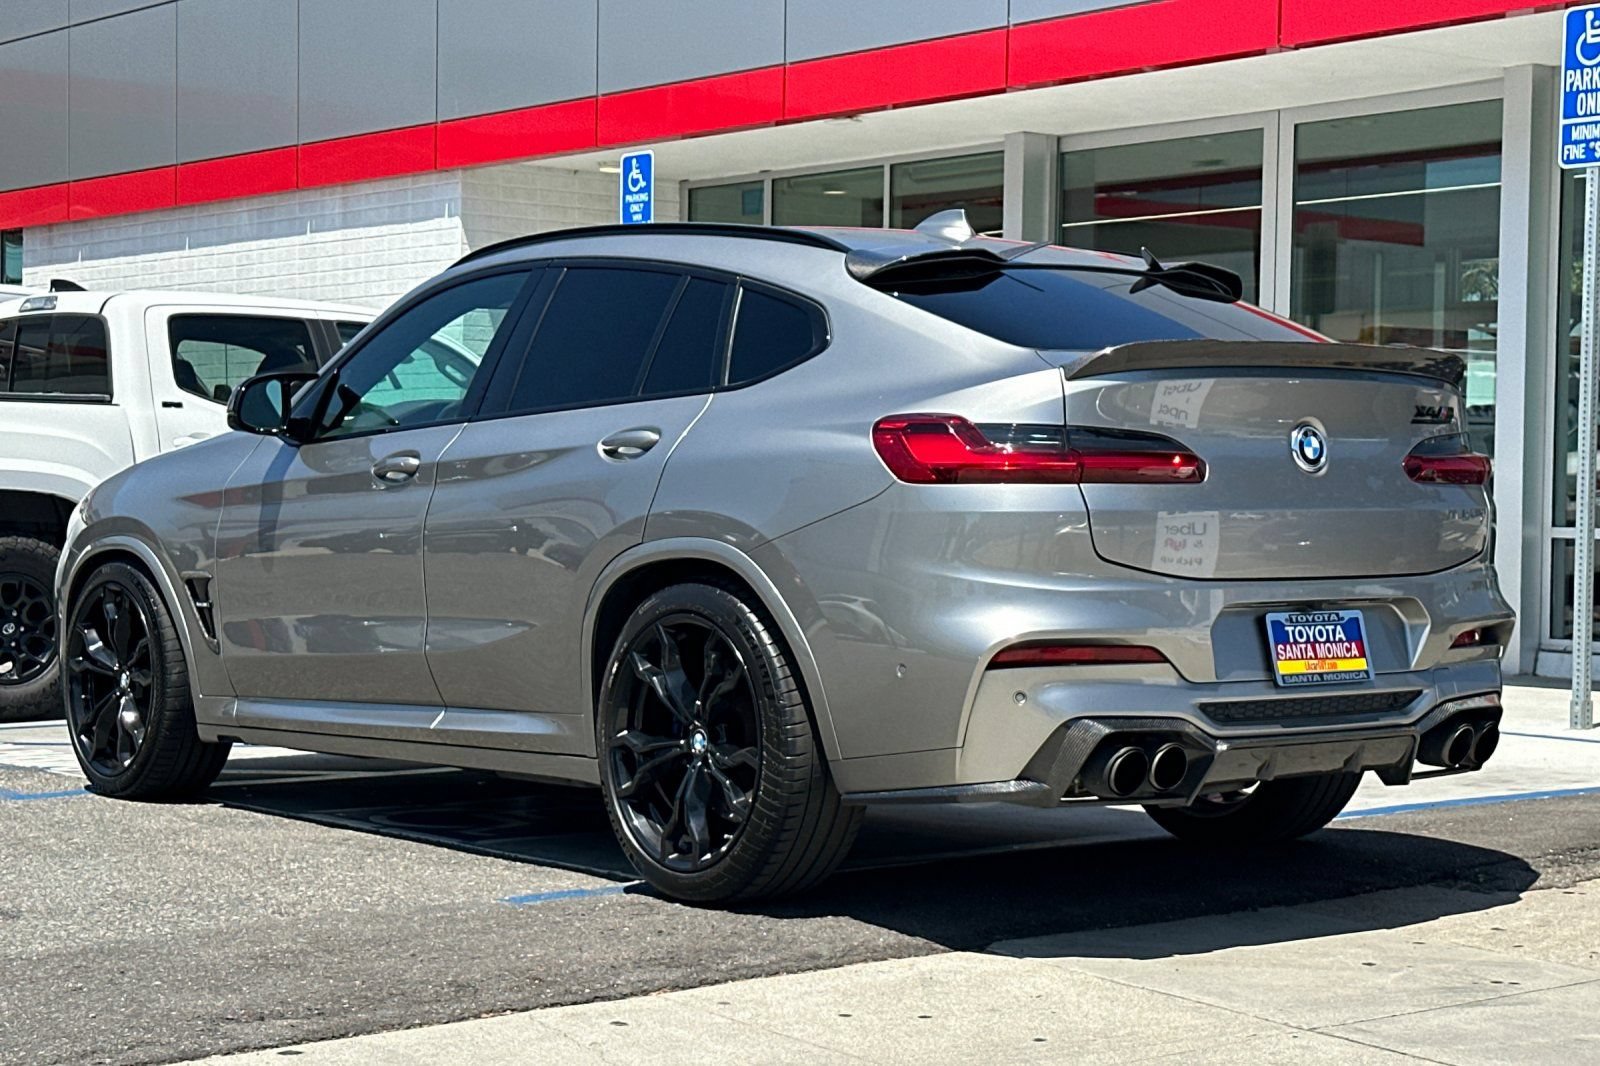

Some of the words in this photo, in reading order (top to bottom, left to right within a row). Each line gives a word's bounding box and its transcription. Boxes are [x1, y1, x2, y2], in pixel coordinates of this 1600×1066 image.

[1563, 143, 1586, 160] FINE
[1290, 613, 1338, 623] TOYOTA
[1284, 625, 1346, 643] TOYOTA
[1277, 643, 1315, 660] SANTA
[1315, 642, 1360, 660] MONICA
[1283, 673, 1321, 684] SANTA
[1323, 671, 1368, 682] MONICA
